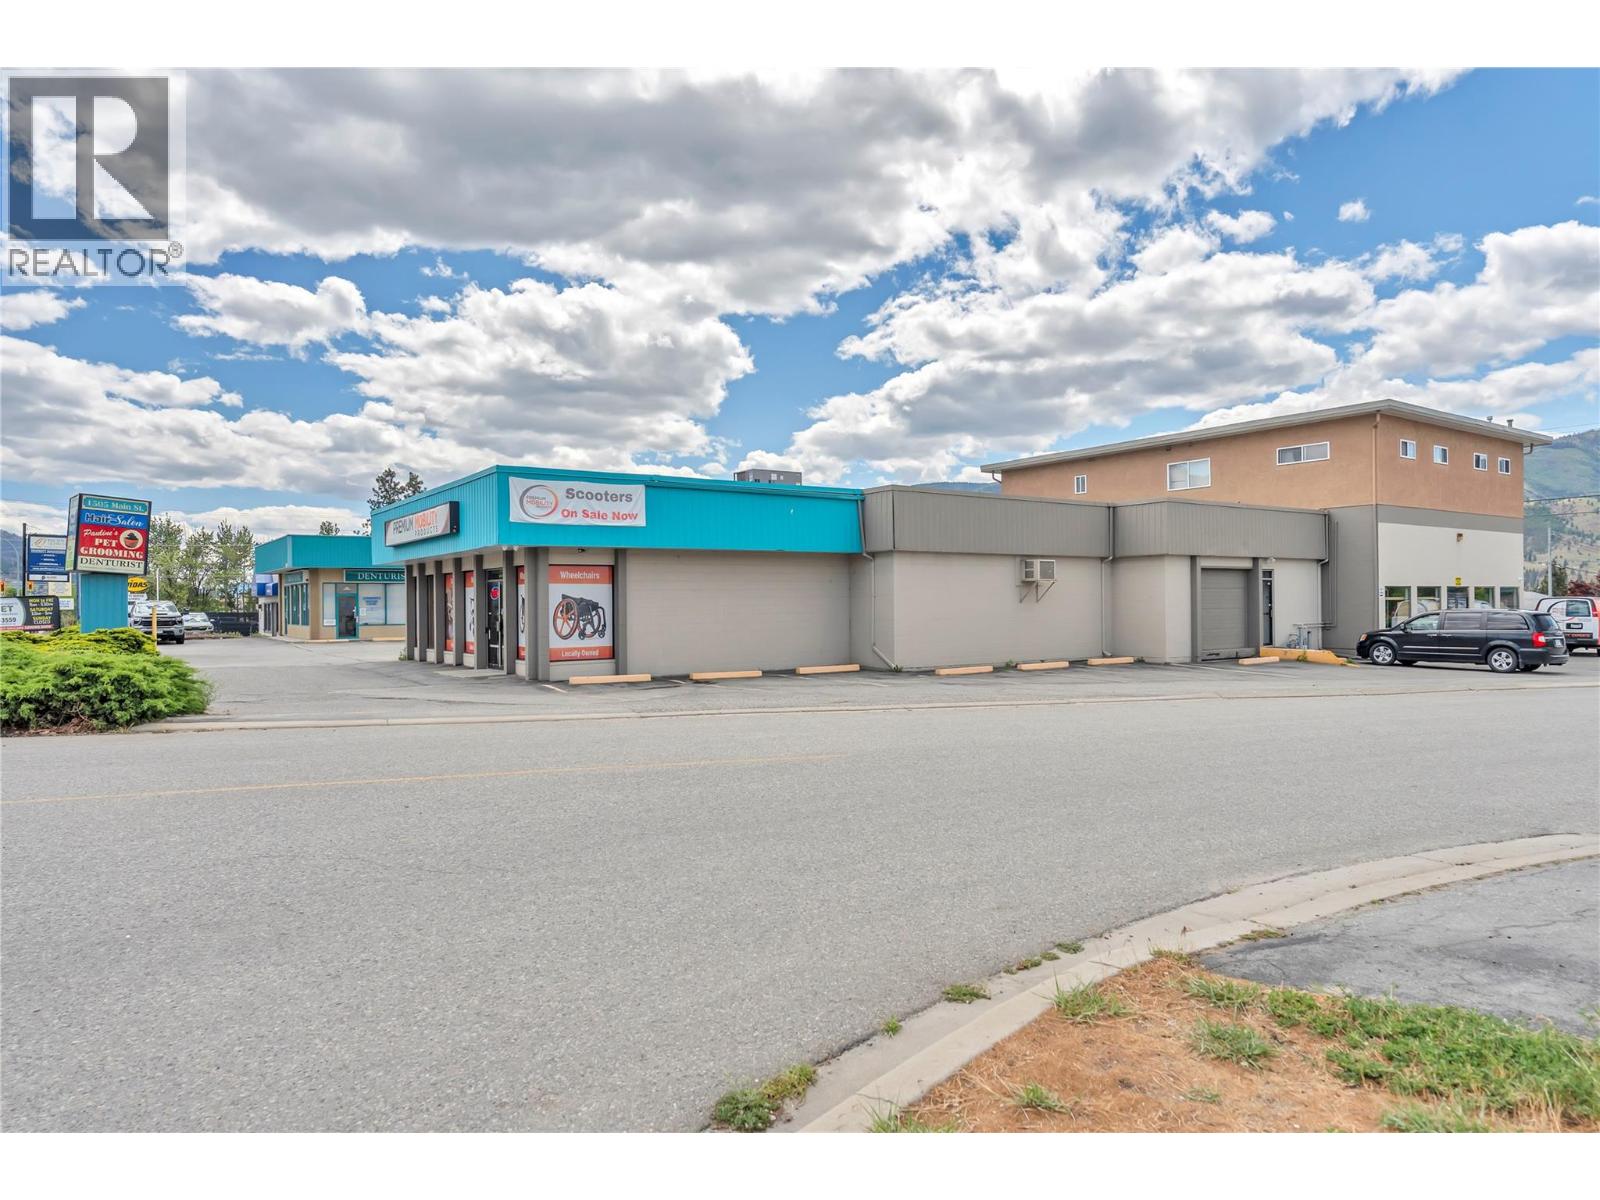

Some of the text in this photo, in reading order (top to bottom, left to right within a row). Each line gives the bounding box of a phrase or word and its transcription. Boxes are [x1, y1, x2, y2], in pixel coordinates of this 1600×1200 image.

[565, 487, 633, 503] Scooters
[112, 502, 132, 510] Main
[561, 509, 638, 521] On Sale Now
[115, 515, 144, 527] Salon
[94, 538, 119, 547] PET
[80, 546, 144, 559] GROOMING
[80, 557, 143, 568] DENTURIST
[358, 572, 406, 580] DENTURIS
[560, 571, 600, 580] Wheelchairs
[561, 649, 580, 657] Locally
